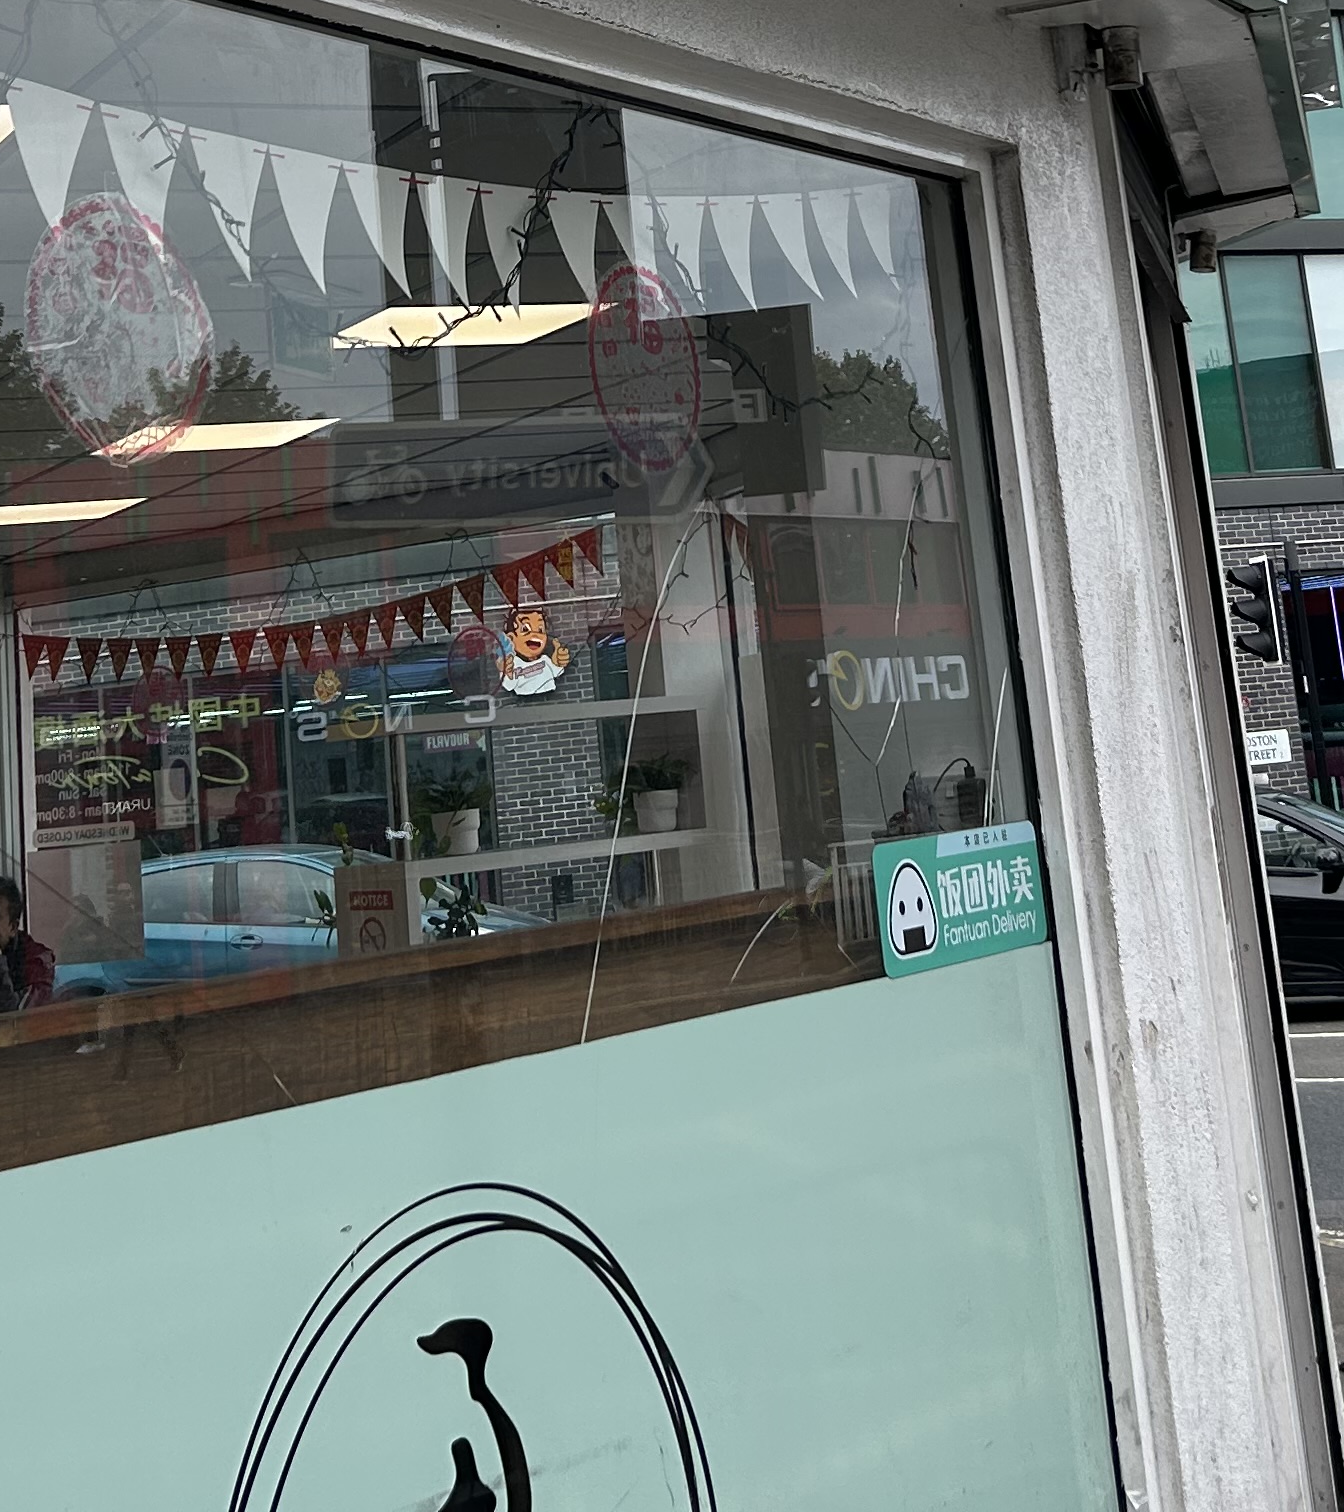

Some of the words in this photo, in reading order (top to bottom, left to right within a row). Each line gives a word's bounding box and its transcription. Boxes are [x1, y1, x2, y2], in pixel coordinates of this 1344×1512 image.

[426, 732, 470, 749] FLAVOUR
[1246, 734, 1278, 747] OSTON
[1249, 748, 1277, 762] TREET
[937, 855, 1034, 918] 饭团外卖
[353, 894, 389, 907] NOTICE
[943, 917, 990, 946] Fantuan
[992, 910, 1036, 937] Delivery
